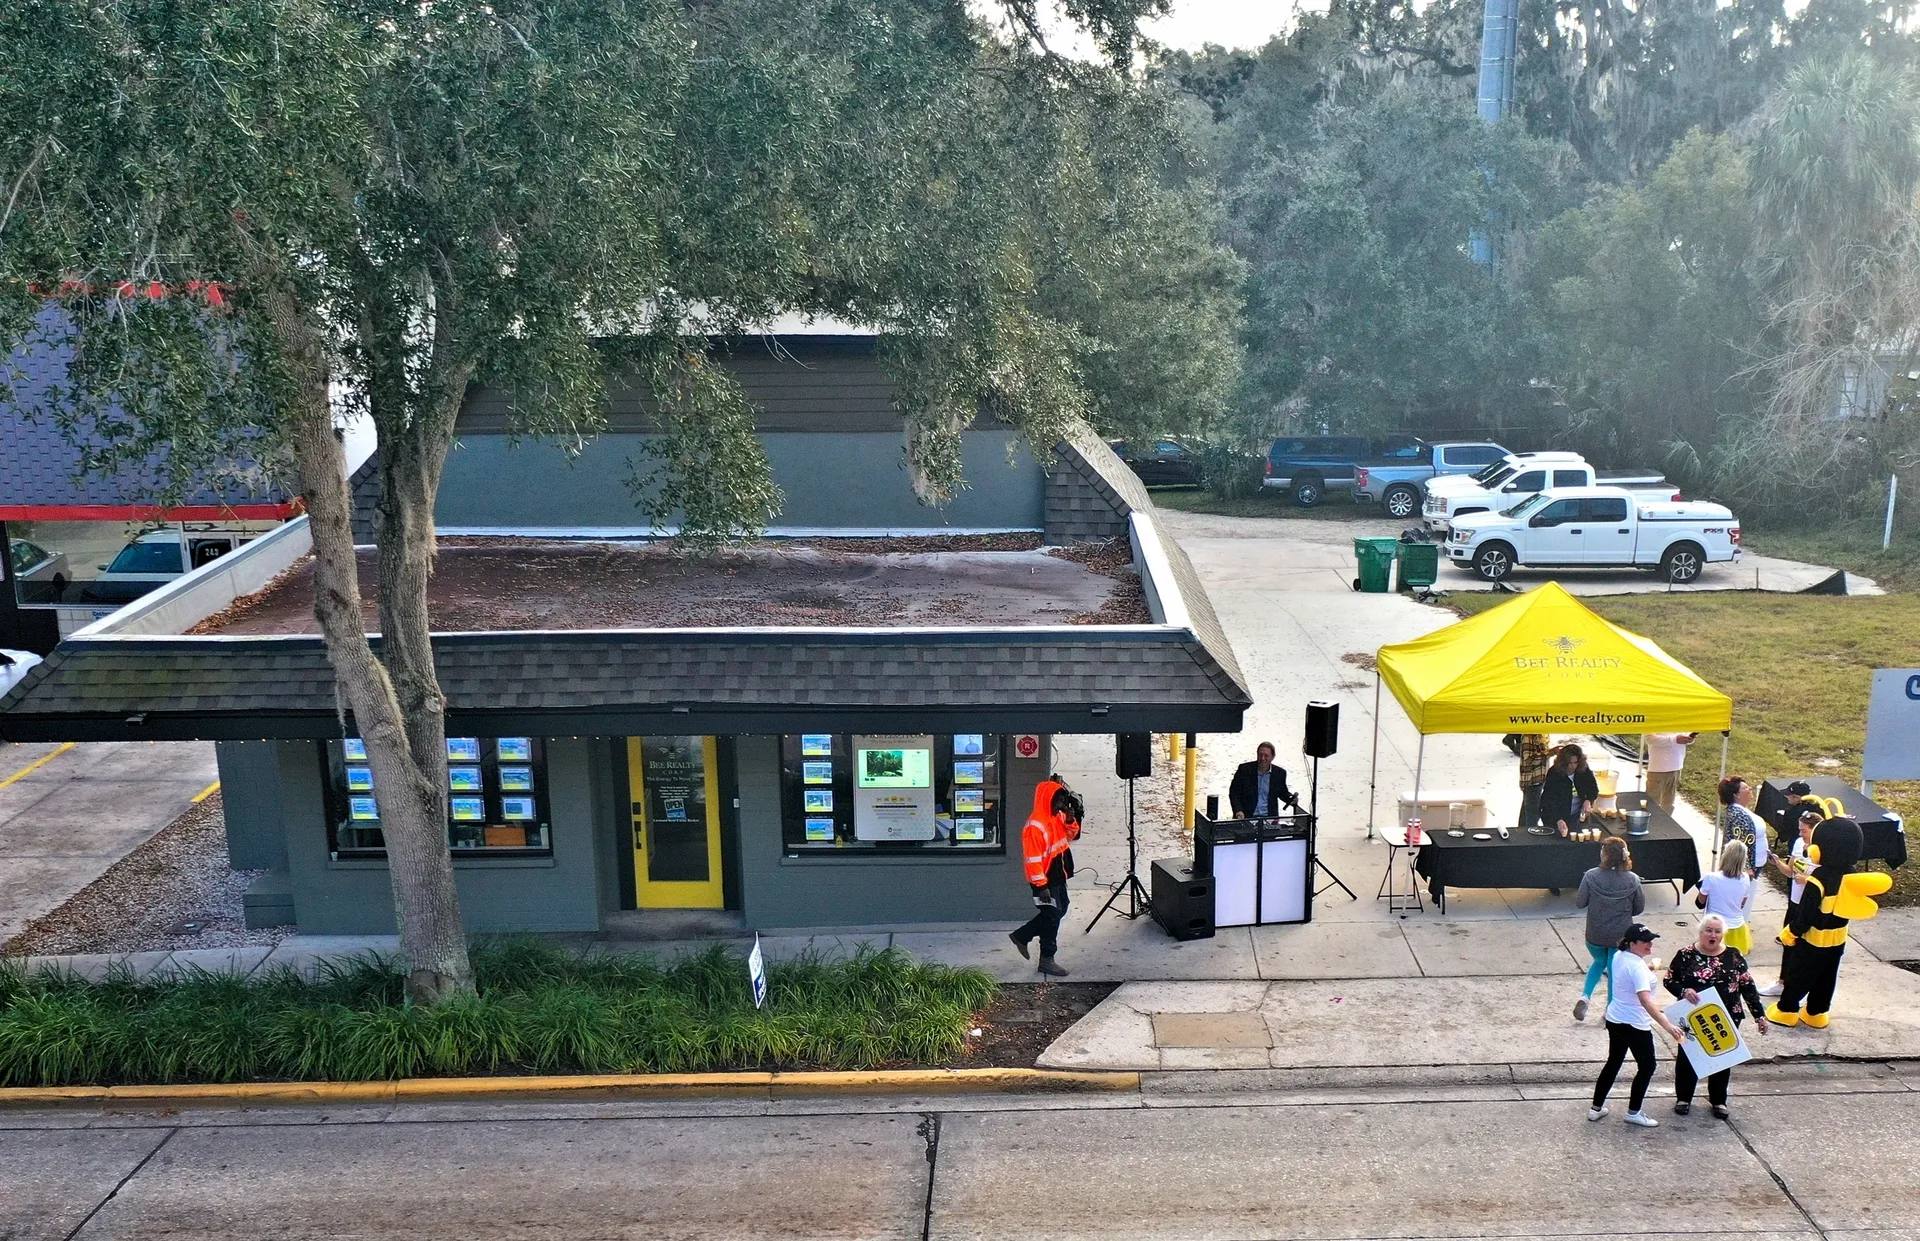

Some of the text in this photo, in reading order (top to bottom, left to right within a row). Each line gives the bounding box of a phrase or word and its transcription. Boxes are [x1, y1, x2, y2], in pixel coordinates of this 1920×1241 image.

[205, 548, 219, 556] 243
[1514, 656, 1620, 668] BEE REALTY
[1509, 712, 1645, 725] www.bee-realty.com
[666, 800, 684, 810] OPEN
[1710, 1013, 1728, 1038] Bee
[1695, 1014, 1721, 1051] Mighty
